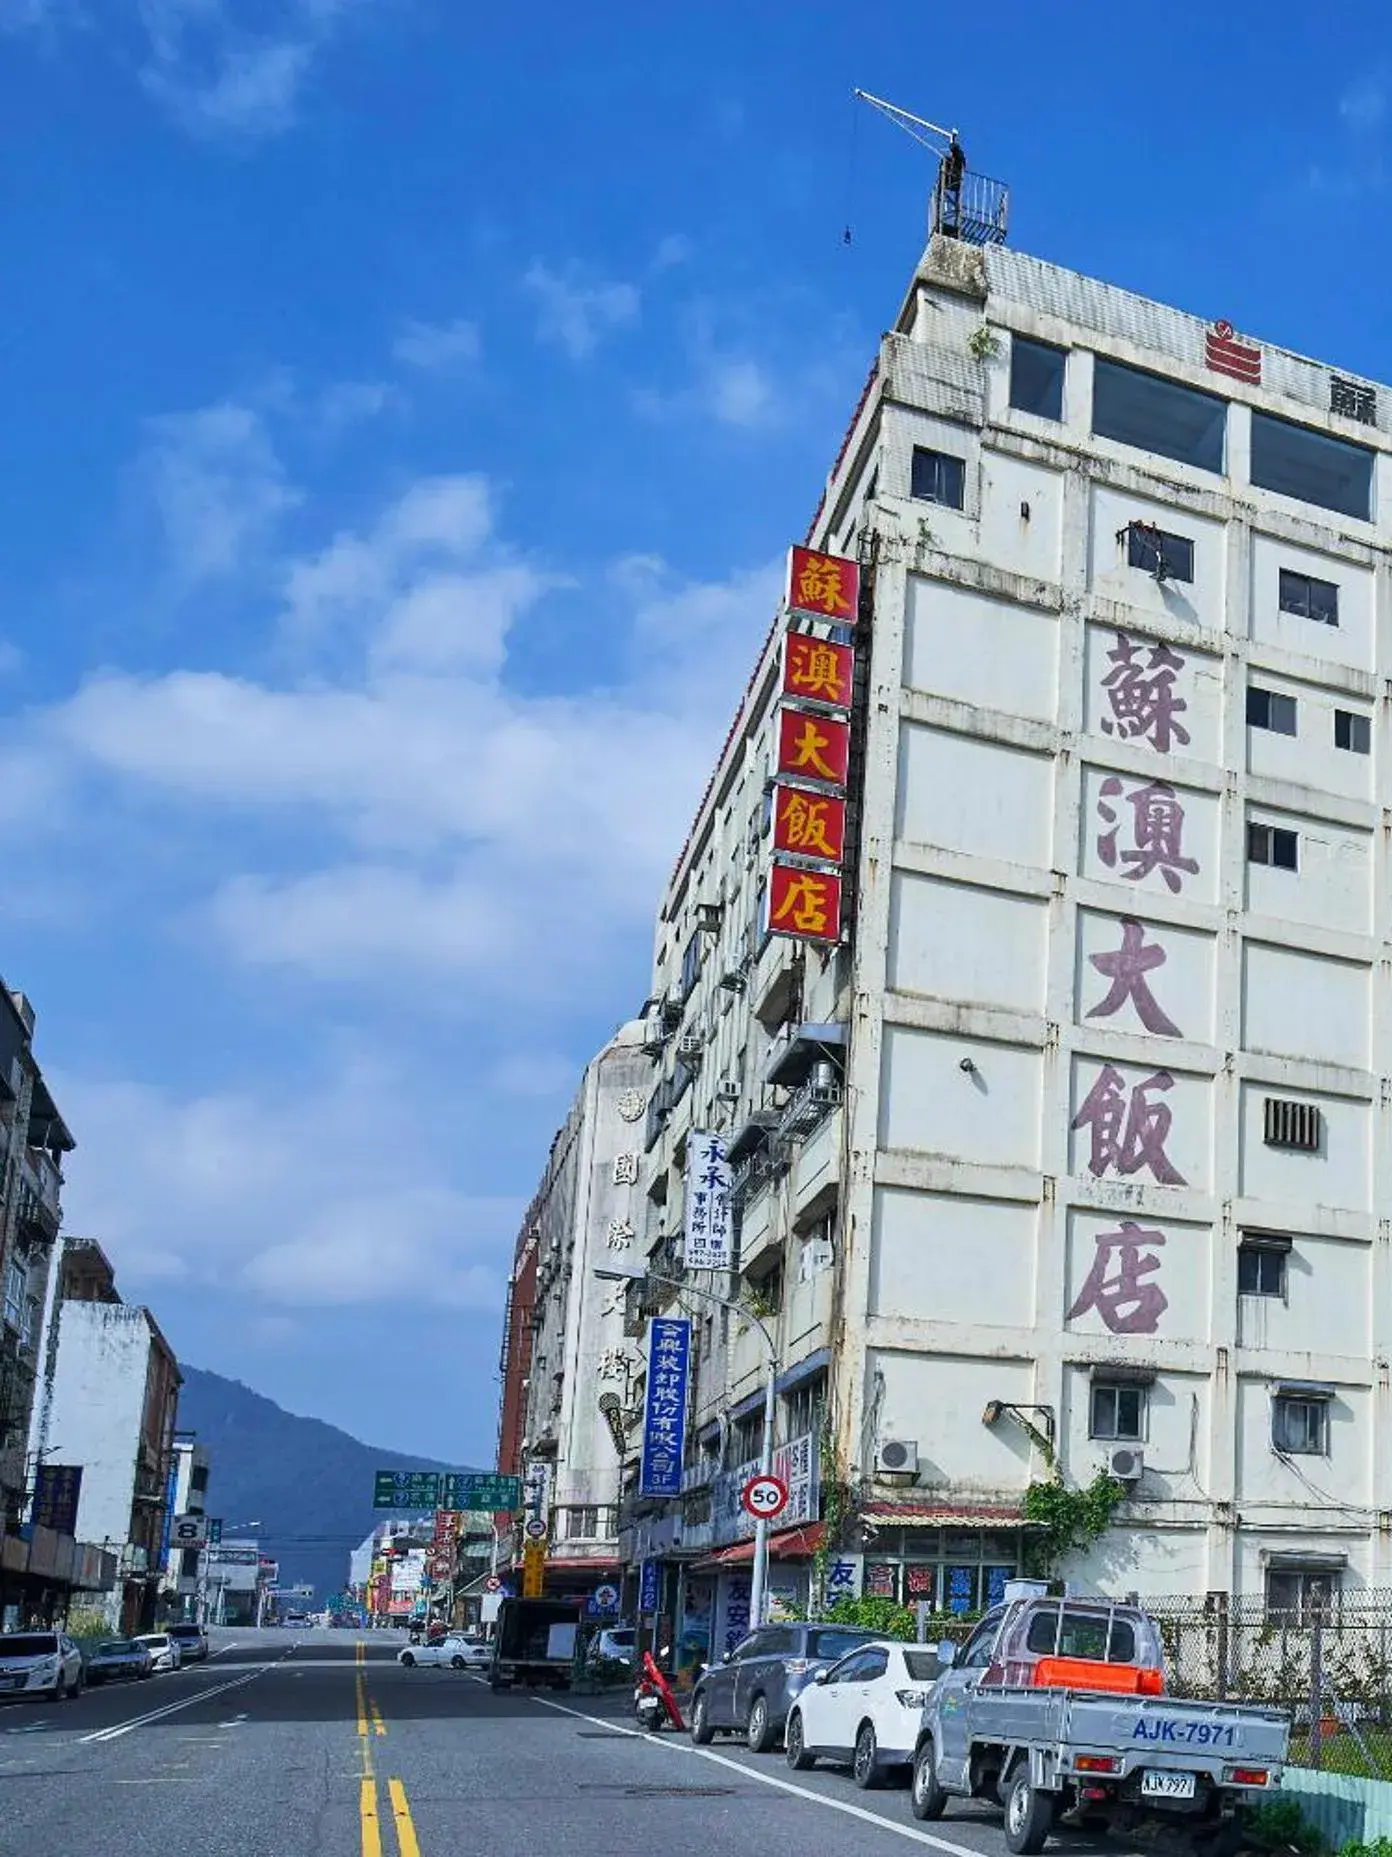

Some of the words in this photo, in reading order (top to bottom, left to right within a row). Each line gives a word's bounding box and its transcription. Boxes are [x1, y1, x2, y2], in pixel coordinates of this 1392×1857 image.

[773, 556, 851, 932] 蘇澳大飯店
[1066, 633, 1200, 1335] 蘇澳大飯店
[652, 1474, 672, 1486] 3F
[752, 1489, 779, 1505] 50
[1132, 1718, 1234, 1747] AJK-7971
